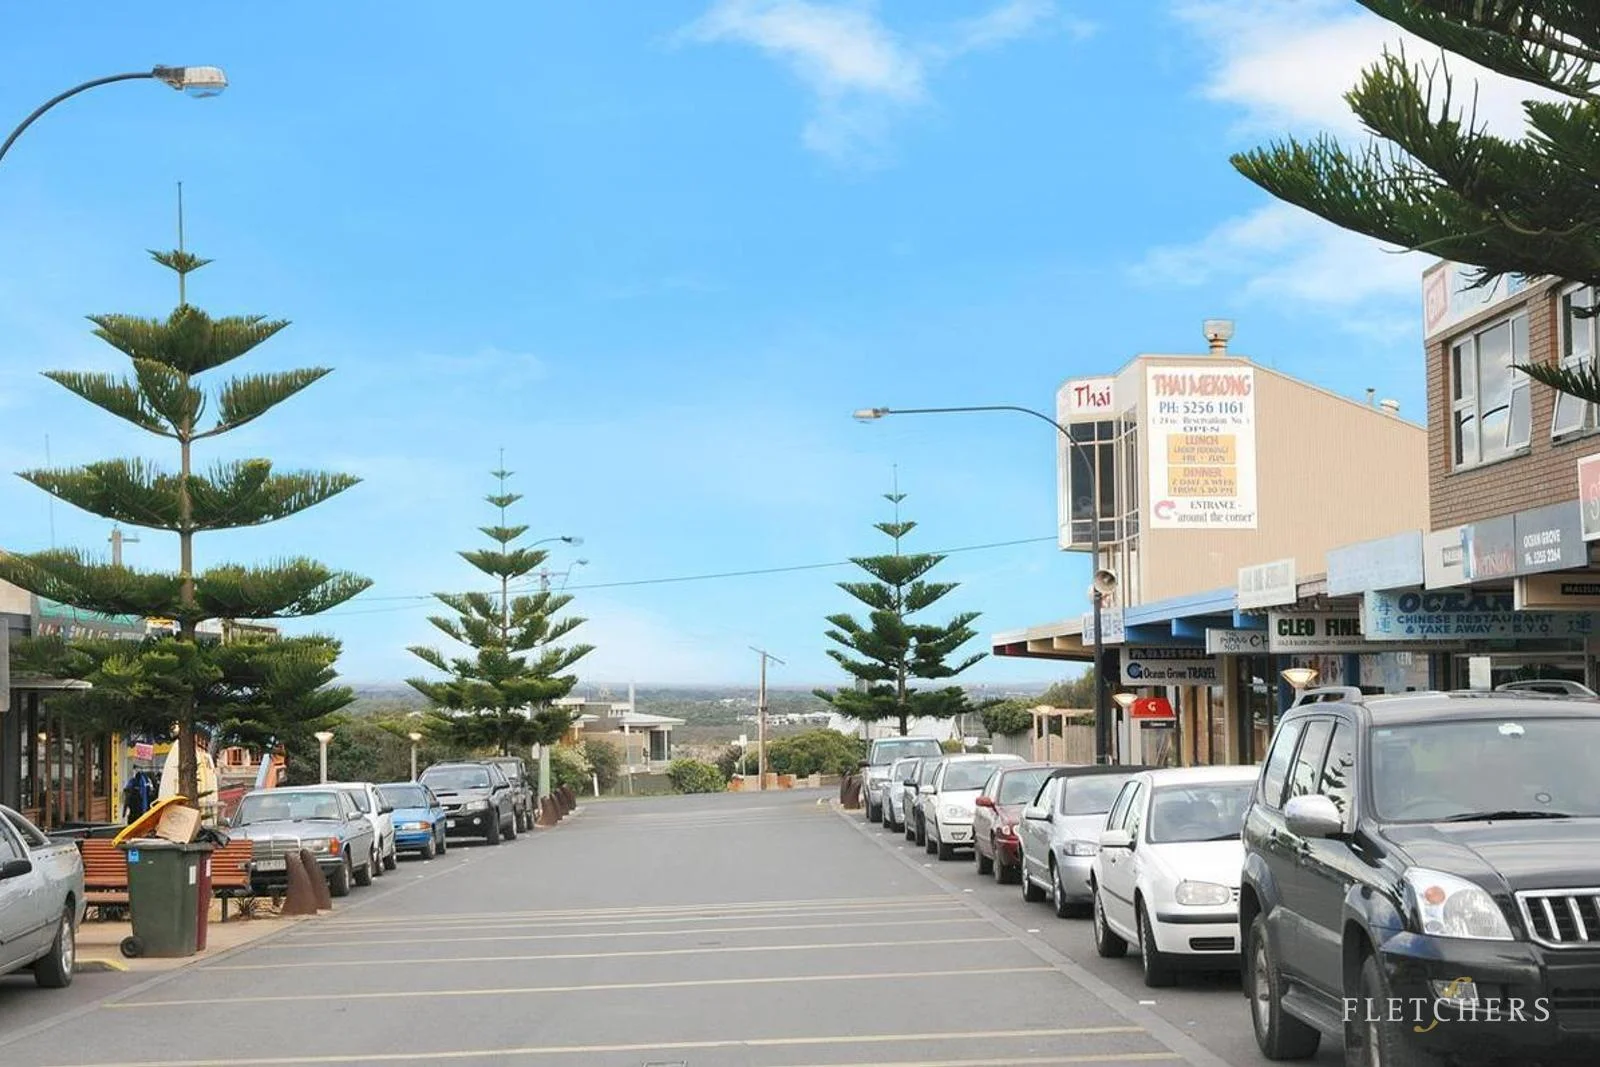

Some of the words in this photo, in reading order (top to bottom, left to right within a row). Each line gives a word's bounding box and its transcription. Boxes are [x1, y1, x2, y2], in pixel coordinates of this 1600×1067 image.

[1152, 374, 1187, 396] THAI
[1187, 374, 1252, 396] MEKONG
[1074, 384, 1111, 408] Thai
[1159, 401, 1179, 414] PH:
[1183, 401, 1214, 414] 5256
[1219, 401, 1244, 414] 1161
[1185, 435, 1219, 445] LUNCH
[1183, 467, 1223, 477] DINNER
[1190, 501, 1236, 509] ENTRANCE
[1210, 511, 1224, 522] the
[1542, 528, 1561, 545] GROVE
[1397, 614, 1451, 624] CHINESE
[1456, 613, 1553, 624] RESTAURANT
[1277, 618, 1316, 636] CLEO
[1405, 625, 1414, 633] &
[1419, 625, 1451, 634] TAKE
[1455, 624, 1493, 634] AWAY
[1144, 668, 1166, 679] Ocean
[1167, 667, 1187, 679] Grove
[1186, 667, 1217, 679] TRAVEL
